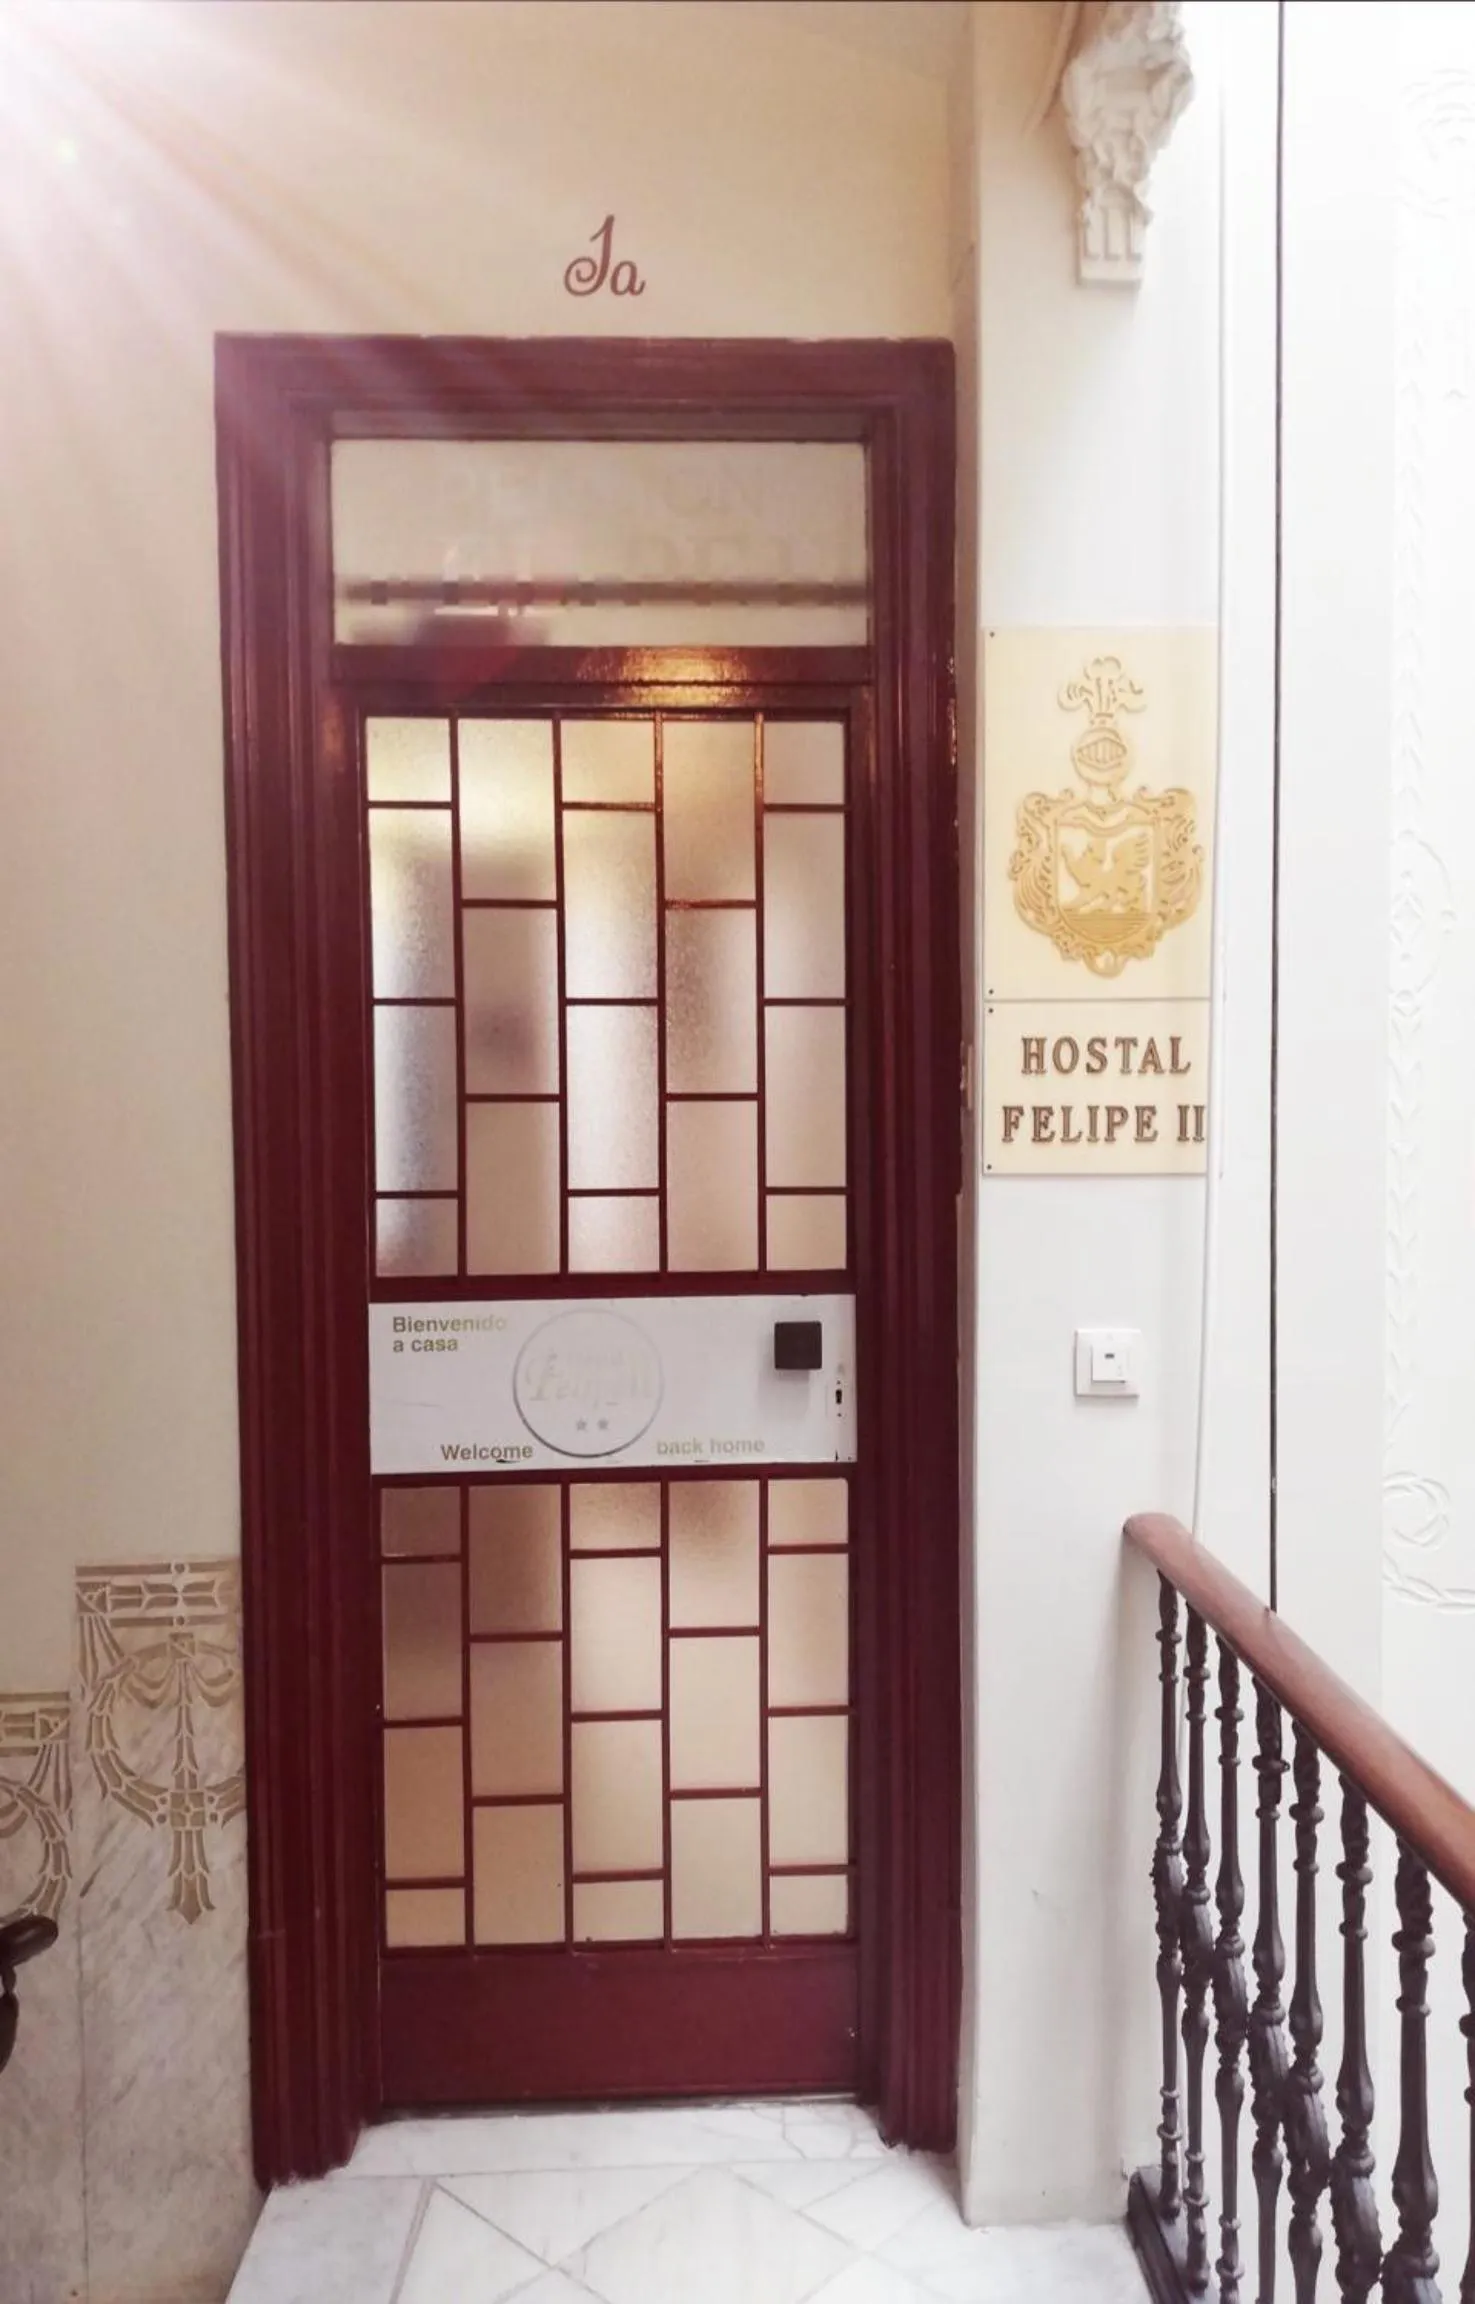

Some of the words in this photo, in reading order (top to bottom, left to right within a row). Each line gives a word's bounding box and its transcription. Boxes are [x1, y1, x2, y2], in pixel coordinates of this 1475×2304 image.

[1021, 1036, 1191, 1075] HOSTAL
[1001, 1104, 1159, 1144] FELIPE
[1176, 1104, 1206, 1144] II
[392, 1315, 507, 1333] Bienvenido
[392, 1339, 404, 1353] a
[411, 1338, 458, 1352] casa
[440, 1443, 533, 1461] Welcome
[657, 1438, 704, 1456] back
[709, 1438, 765, 1454] home
